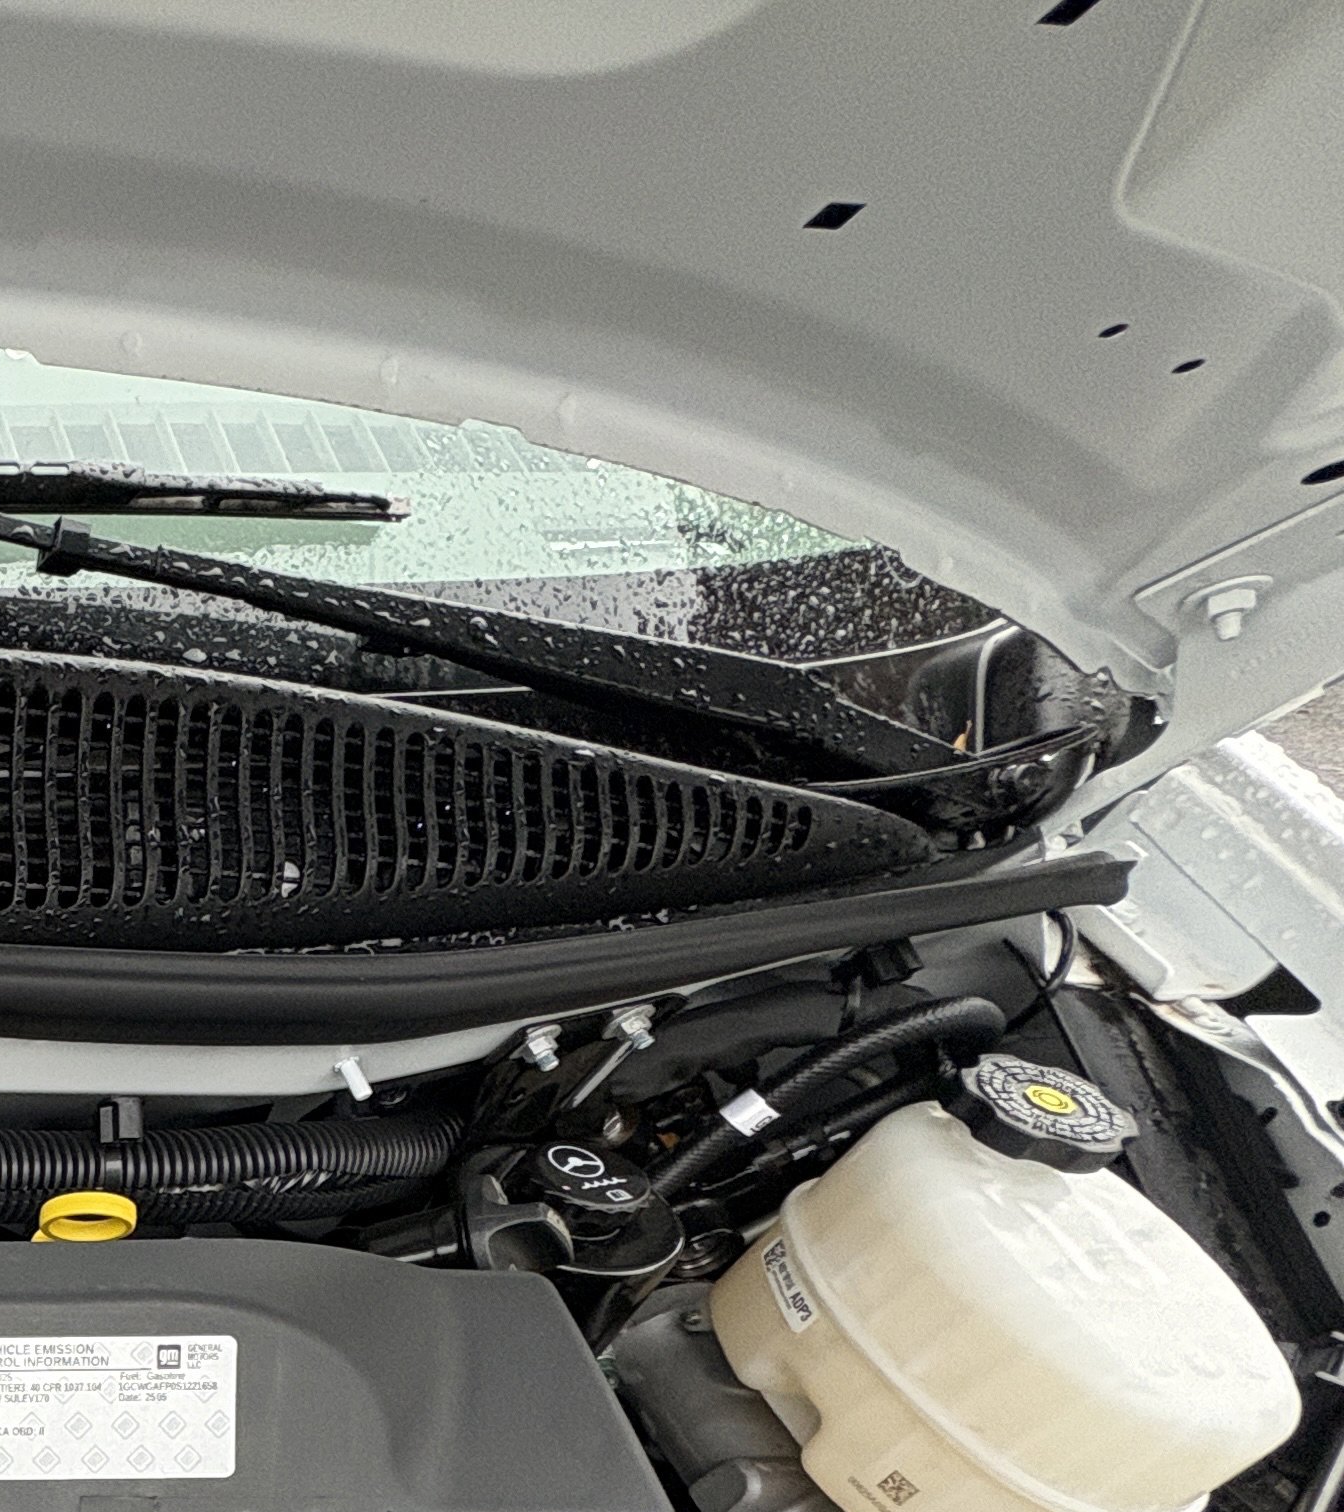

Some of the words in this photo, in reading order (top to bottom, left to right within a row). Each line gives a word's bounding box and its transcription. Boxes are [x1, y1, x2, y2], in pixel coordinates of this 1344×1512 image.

[790, 1292, 812, 1322] ADP3
[34, 1344, 95, 1355] EMISSION
[187, 1344, 223, 1352] GENERAL
[187, 1353, 219, 1361] MOTORS
[23, 1356, 109, 1368] INFORMATION
[146, 1372, 186, 1380] Gasoline
[43, 1383, 62, 1392] CFR
